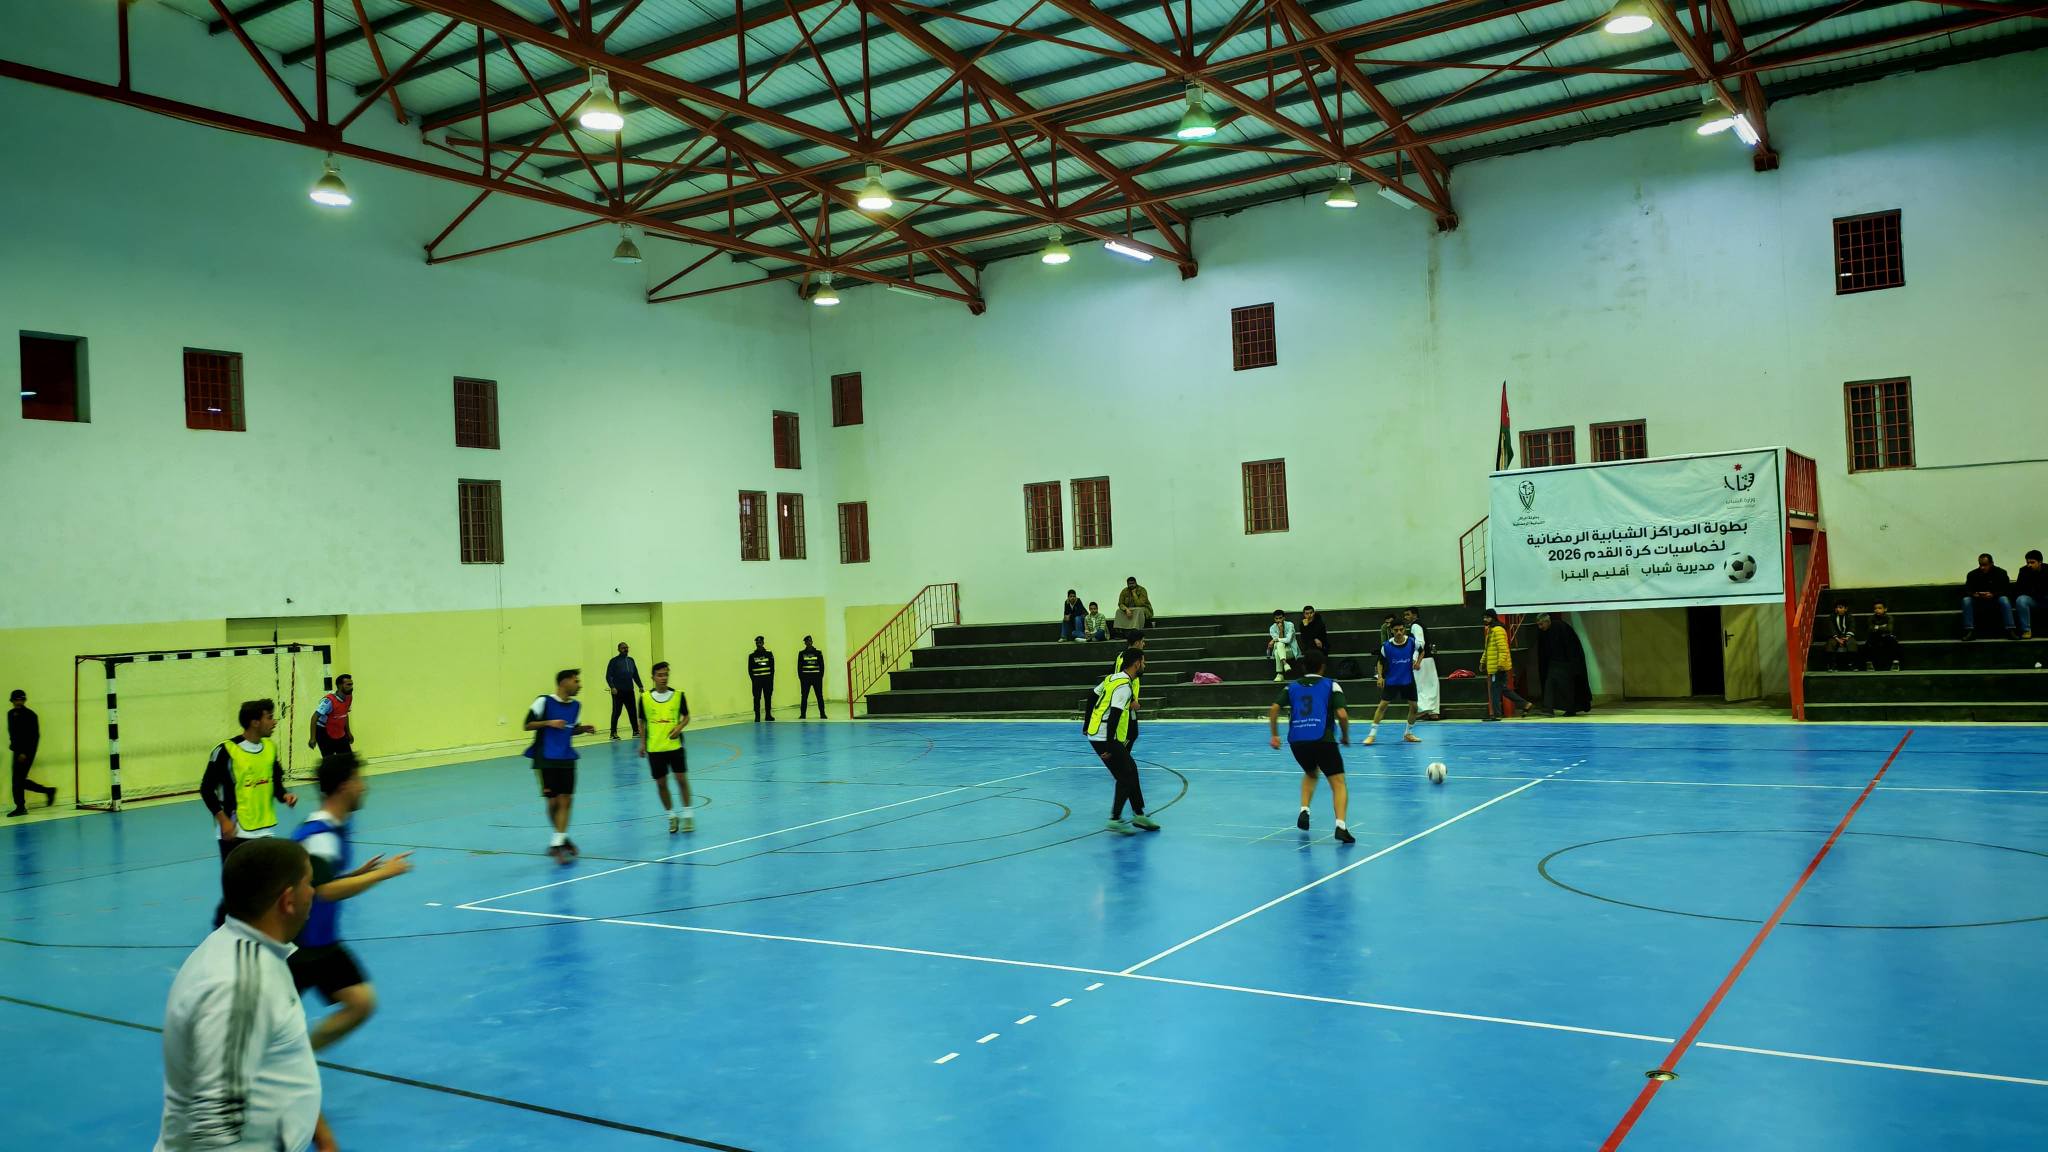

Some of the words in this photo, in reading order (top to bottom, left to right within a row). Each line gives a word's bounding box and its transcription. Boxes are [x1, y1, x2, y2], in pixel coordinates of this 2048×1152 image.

[1592, 526, 1648, 544] الشبابية
[1649, 523, 1701, 540] المراكز
[1704, 521, 1748, 535] بطولة
[1527, 531, 1589, 548] الرمضانية
[1548, 548, 1581, 561] 2026
[1584, 546, 1622, 561] القدم
[1625, 545, 1651, 559] كرة
[1654, 539, 1726, 557] لخماسيات
[1561, 568, 1589, 582] البترا
[1592, 563, 1630, 581] أقليم
[1641, 562, 1672, 576] شباب
[1676, 562, 1715, 575] مديرية
[1301, 695, 1313, 716] 3
